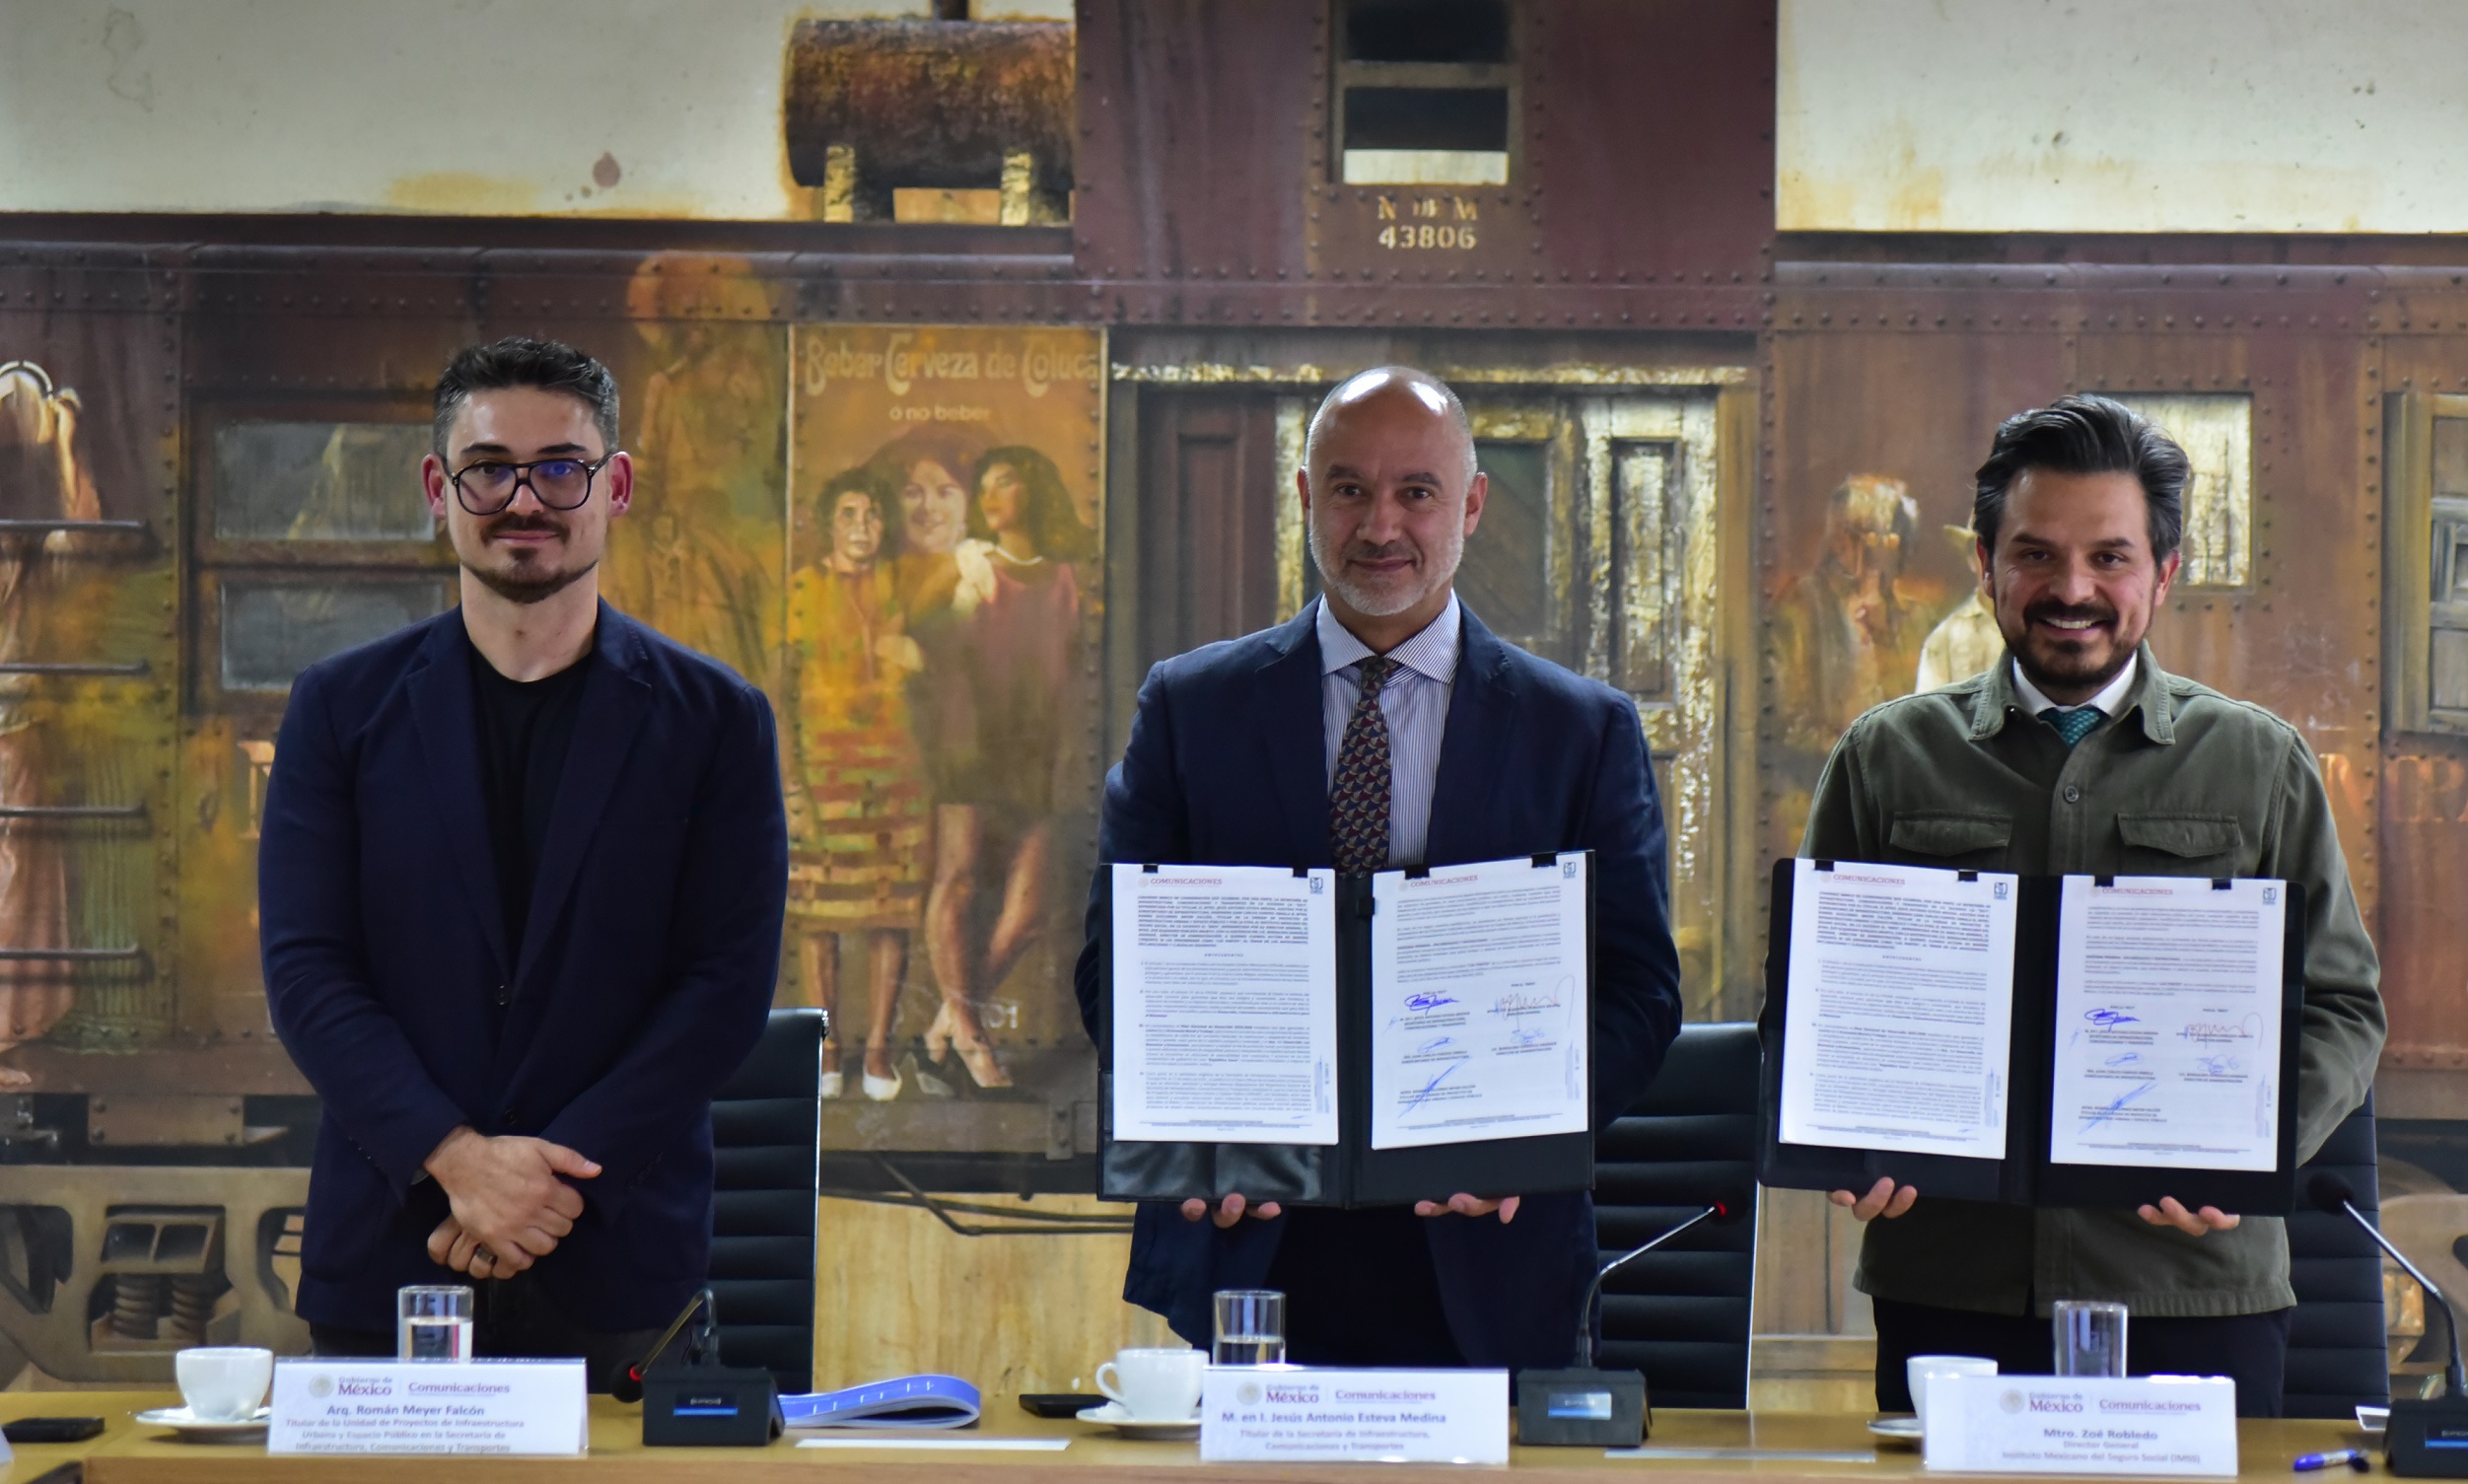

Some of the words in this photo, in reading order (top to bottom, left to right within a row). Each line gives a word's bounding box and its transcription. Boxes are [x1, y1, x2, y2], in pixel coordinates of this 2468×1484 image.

[1378, 225, 1478, 249] 43806
[805, 332, 883, 396] Beber
[884, 332, 979, 395] Cerveza
[986, 338, 1017, 379] de
[905, 407, 931, 421] no
[338, 1382, 393, 1395] México
[408, 1381, 511, 1393] Comunicaciones
[1266, 1390, 1320, 1403] México
[1335, 1388, 1437, 1400] Comunicaciones
[326, 1405, 352, 1417] Arq.
[356, 1404, 399, 1415] Román
[402, 1405, 443, 1417] Meyer
[446, 1405, 485, 1416] Falcón
[2029, 1399, 2083, 1412] México
[2099, 1399, 2202, 1411] Comunicaciones
[1241, 1413, 1257, 1422] en
[1271, 1412, 1303, 1423] Jesús
[1306, 1412, 1355, 1423] Antonio
[1358, 1412, 1396, 1422] Esteva
[1400, 1412, 1446, 1423] Medina
[392, 1419, 439, 1430] Proyectos
[455, 1420, 525, 1429] Infraestructura
[2043, 1429, 2078, 1439] Mtro.
[2081, 1429, 2104, 1439] Zoé
[2107, 1429, 2158, 1440] Robledo
